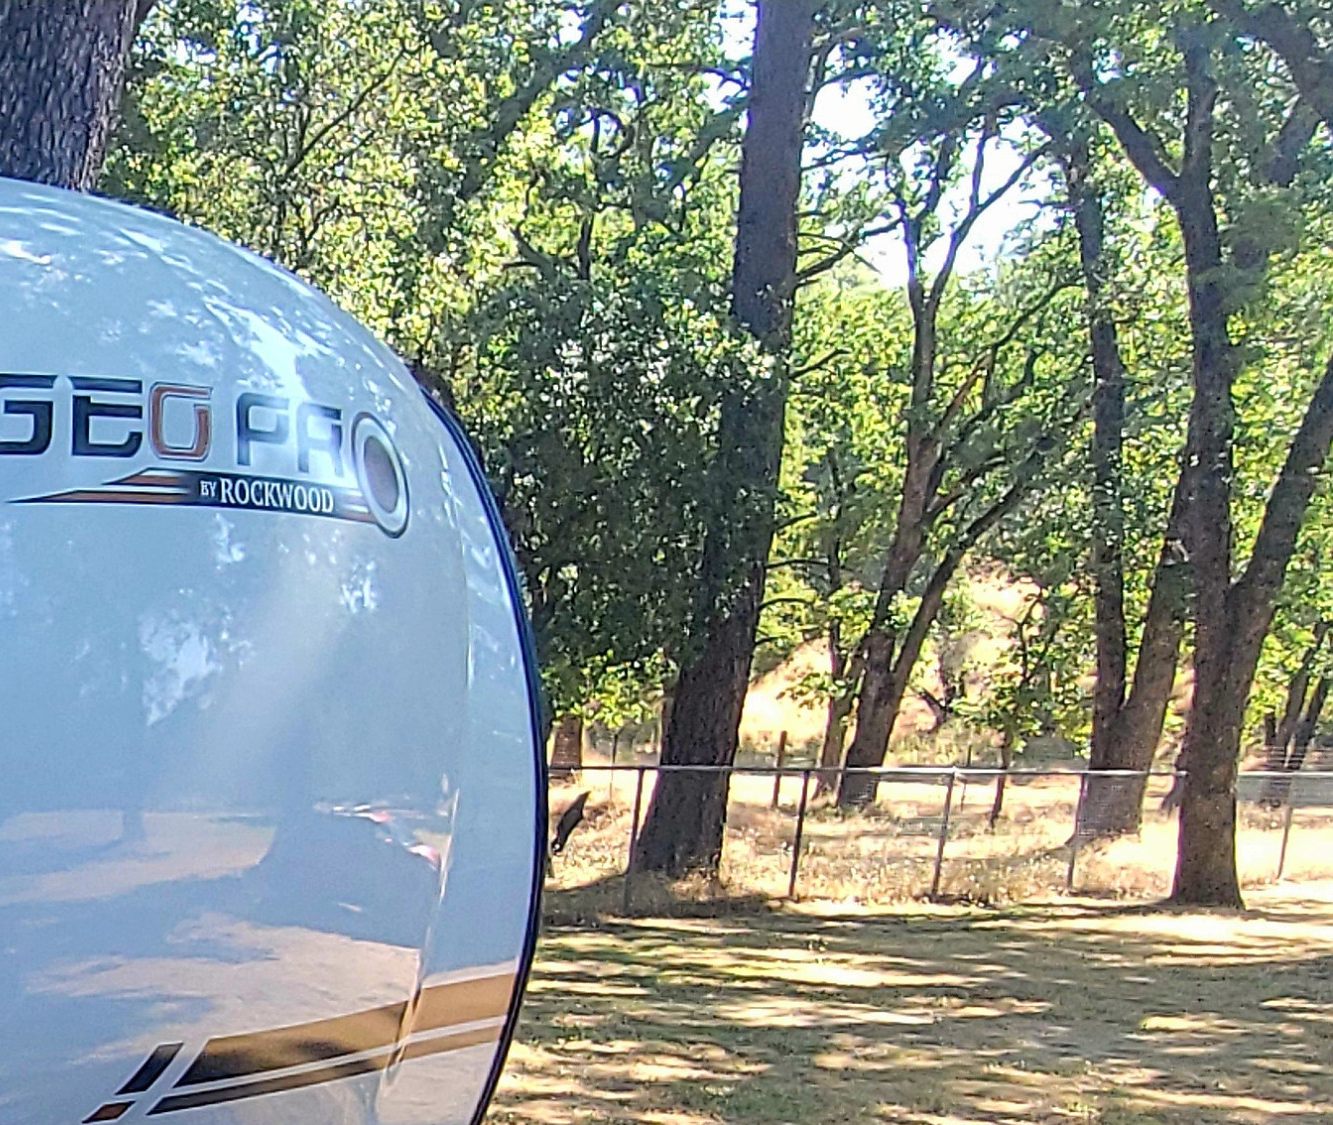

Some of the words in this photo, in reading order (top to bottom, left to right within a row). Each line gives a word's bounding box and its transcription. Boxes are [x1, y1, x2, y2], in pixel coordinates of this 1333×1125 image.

[199, 480, 218, 498] BY
[219, 477, 335, 514] ROCKWOOD
[236, 390, 411, 540] PRO
